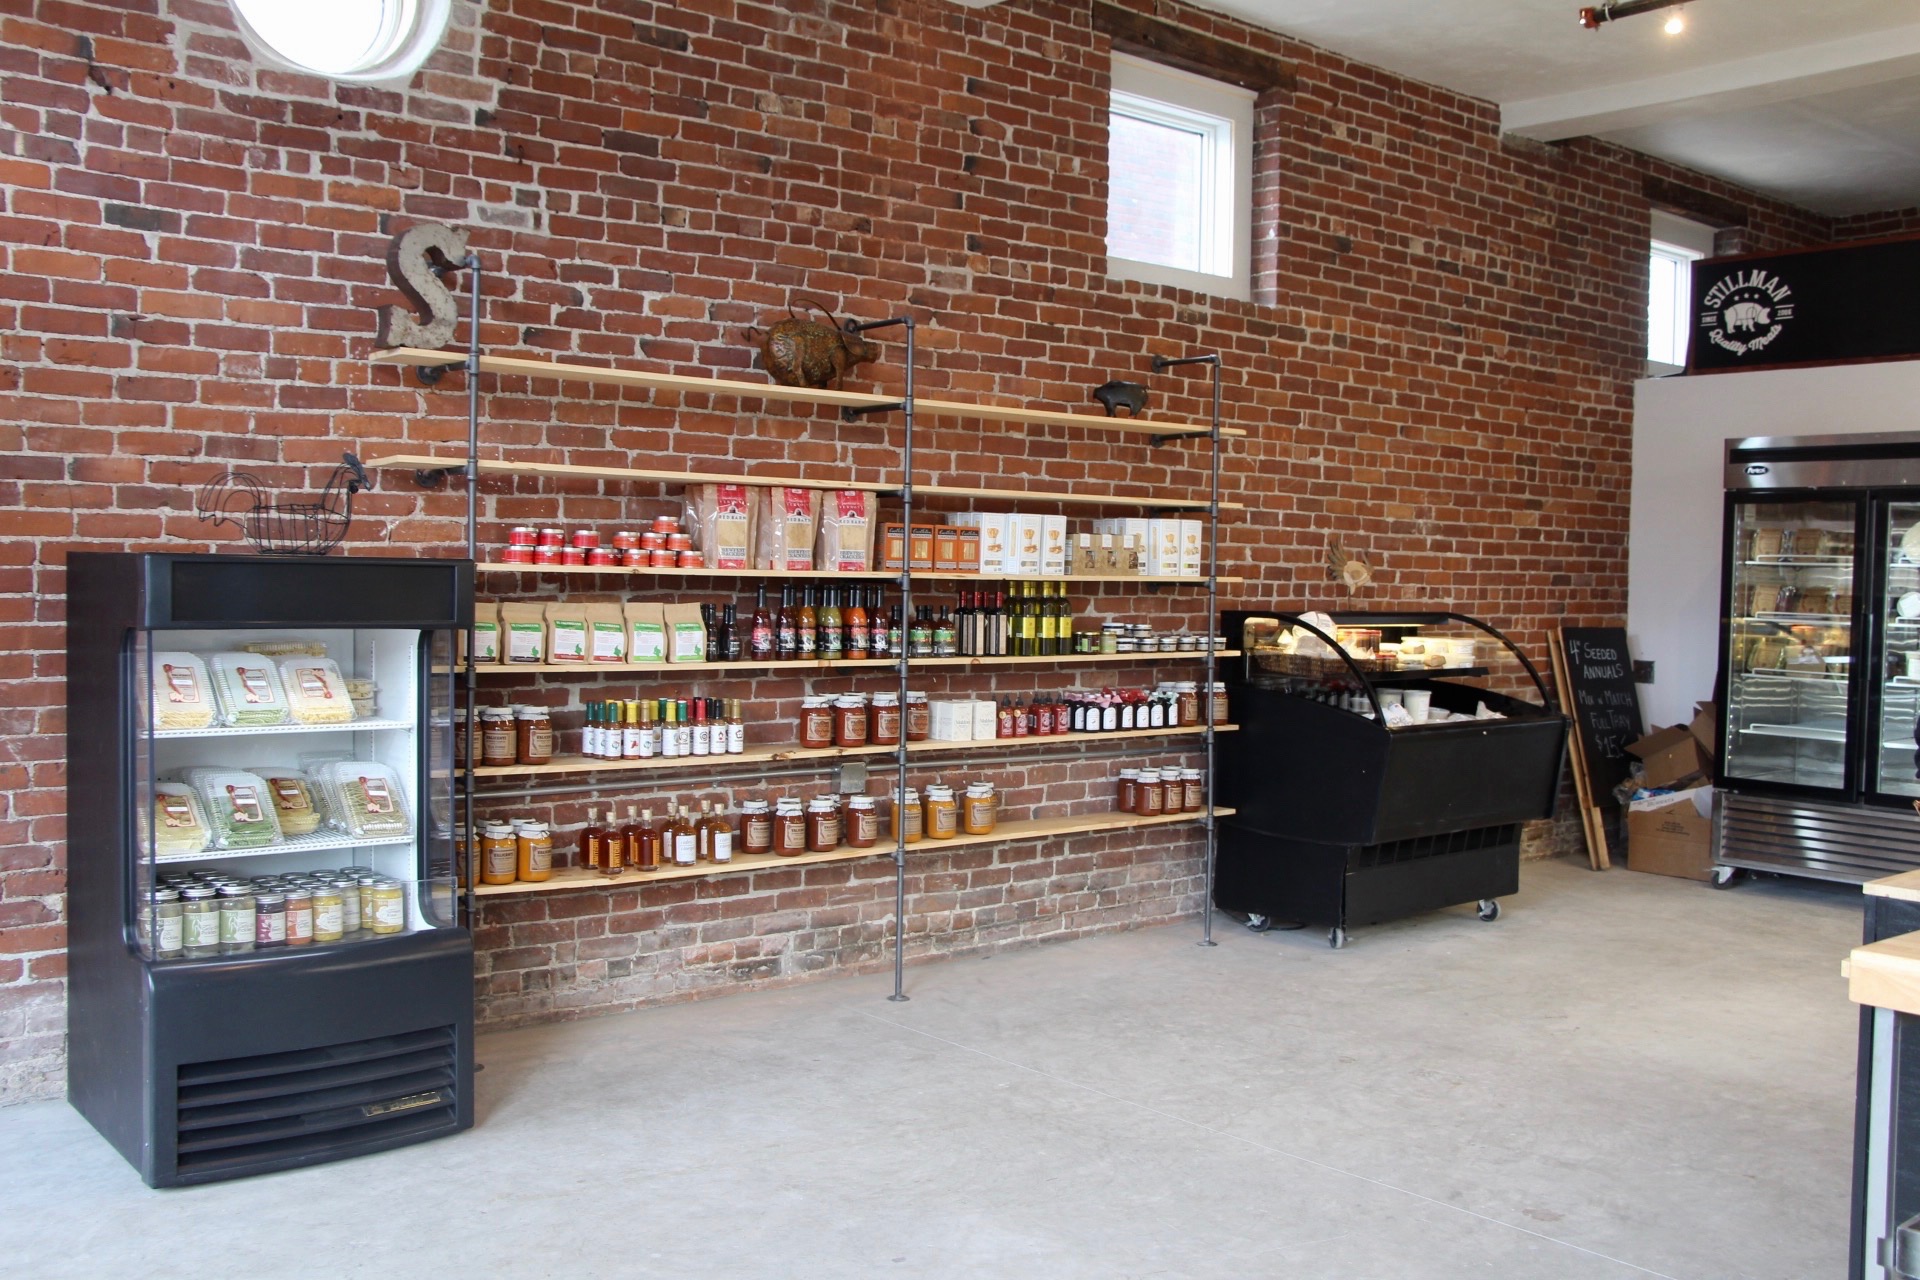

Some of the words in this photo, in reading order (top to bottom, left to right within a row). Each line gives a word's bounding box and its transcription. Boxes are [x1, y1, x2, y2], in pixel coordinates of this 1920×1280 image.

[375, 223, 470, 349] S
[1704, 269, 1791, 308] STILLMAN
[1709, 329, 1748, 356] Quality
[1748, 324, 1782, 350] Meats
[1584, 642, 1617, 660] SEEDED
[1584, 663, 1623, 679] ANNUALS
